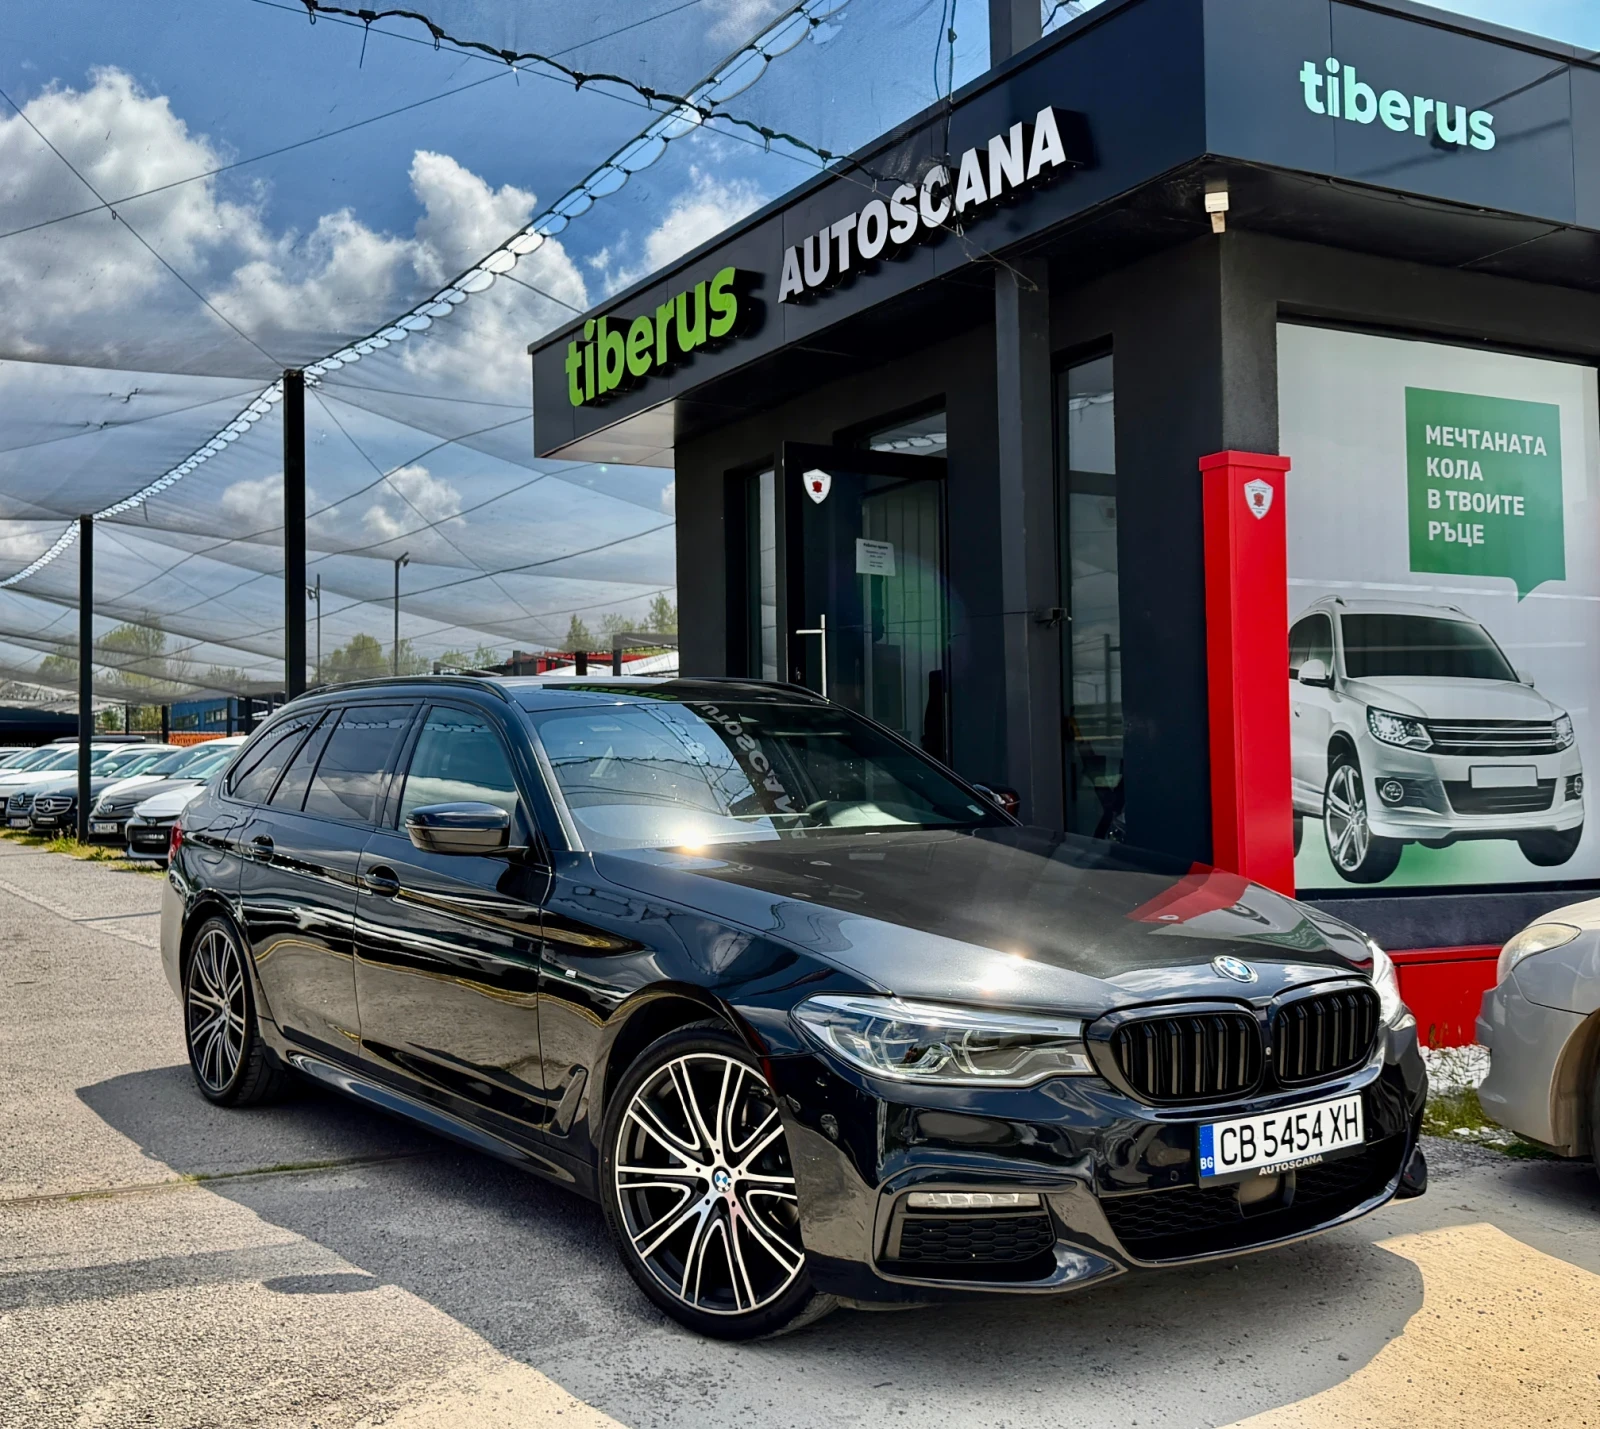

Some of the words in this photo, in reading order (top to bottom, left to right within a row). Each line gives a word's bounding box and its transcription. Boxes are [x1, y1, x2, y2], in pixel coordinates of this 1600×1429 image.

[1299, 56, 1496, 151] tiberus
[565, 266, 738, 407] tiberus
[778, 105, 1067, 303] AUTOSCANA
[1425, 424, 1547, 456] МЕЧТАНАТА
[1426, 456, 1484, 481] КОЛА
[1427, 488, 1441, 509] В
[1445, 490, 1525, 516] ТВОИТЕ
[1428, 521, 1485, 547] РЪЦЕ
[1200, 1157, 1214, 1170] BG
[1220, 1124, 1257, 1166] CB
[1263, 1110, 1323, 1158] 5454
[1329, 1101, 1359, 1144] XH
[1258, 1154, 1323, 1176] AUTOSCANA
